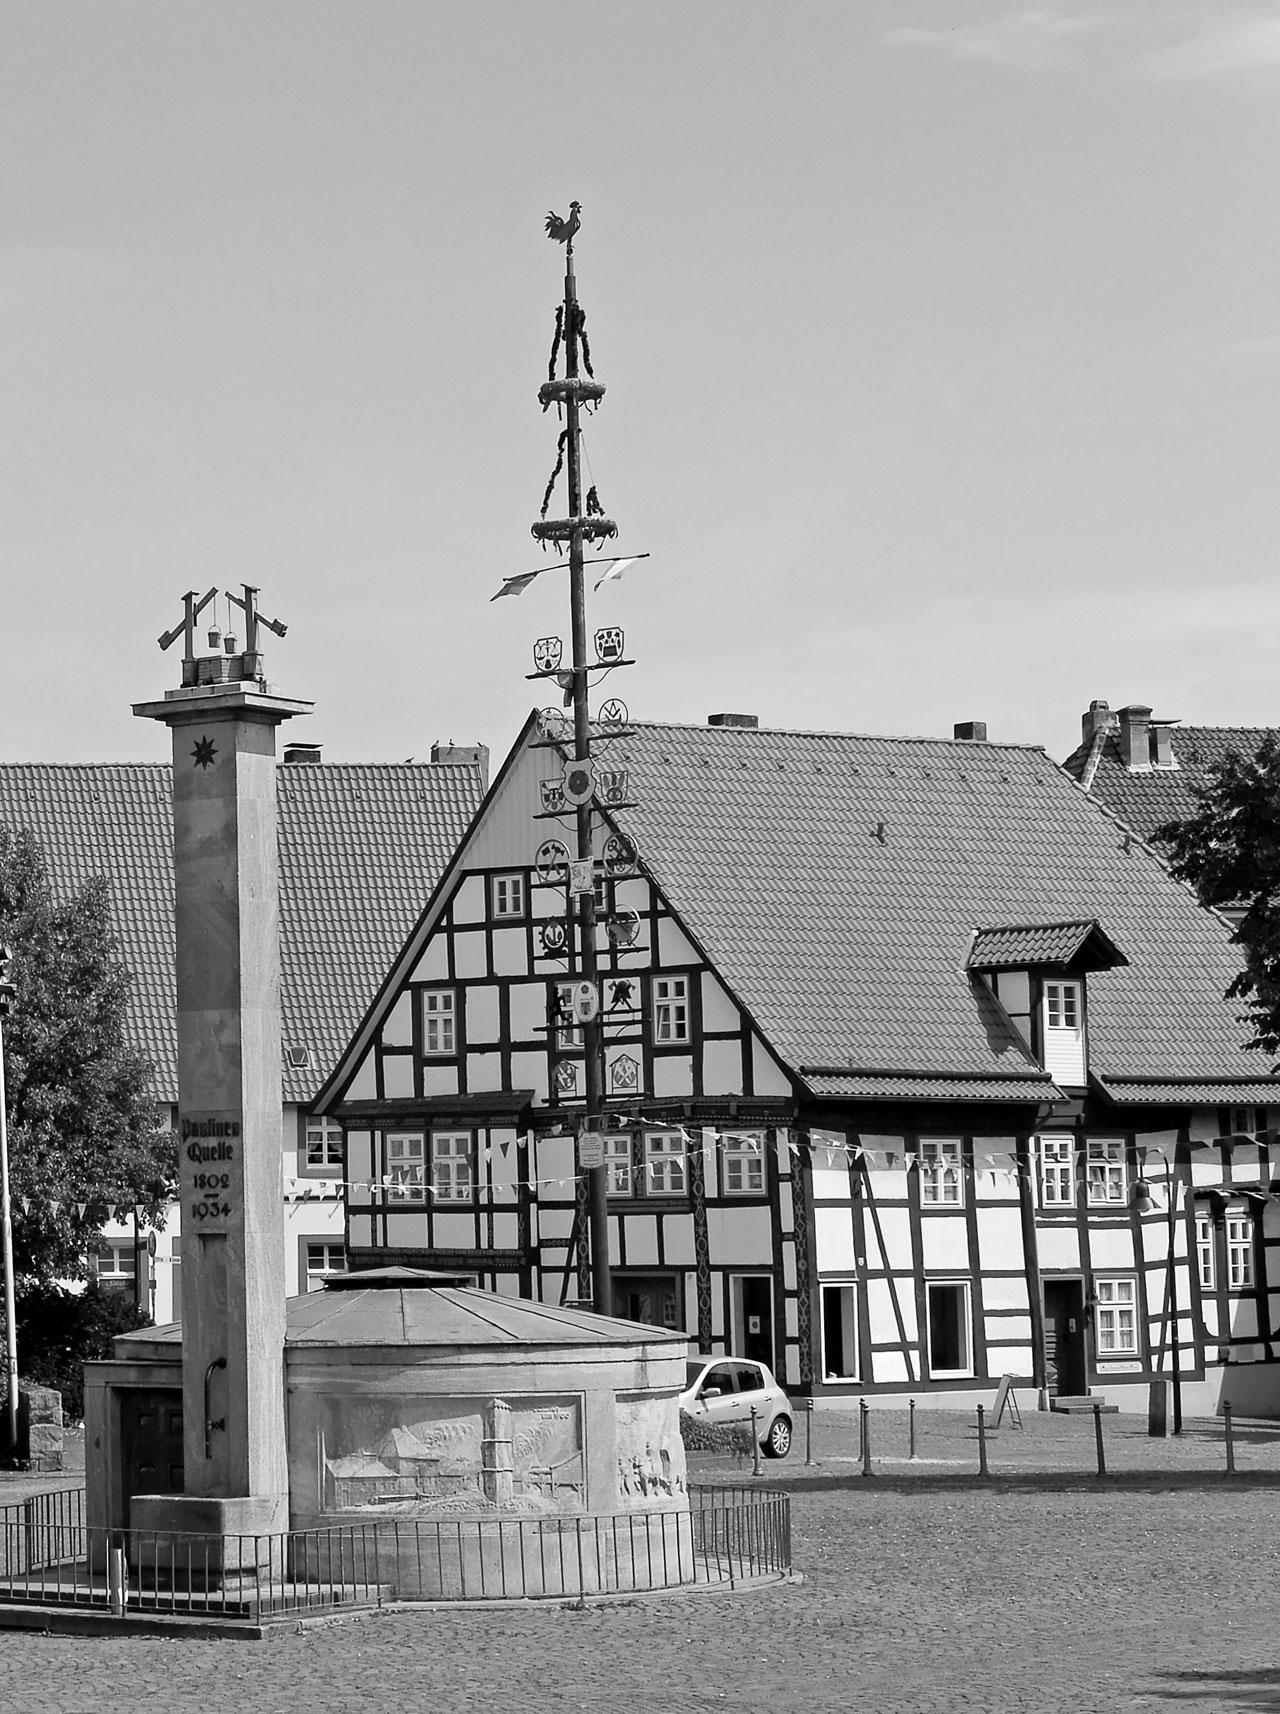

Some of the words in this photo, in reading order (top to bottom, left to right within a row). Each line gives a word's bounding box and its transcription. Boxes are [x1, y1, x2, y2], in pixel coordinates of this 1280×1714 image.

[181, 1118, 240, 1143] Paulinen
[187, 1141, 233, 1164] Quelle
[193, 1173, 230, 1189] 1802
[192, 1202, 232, 1221] 1934
